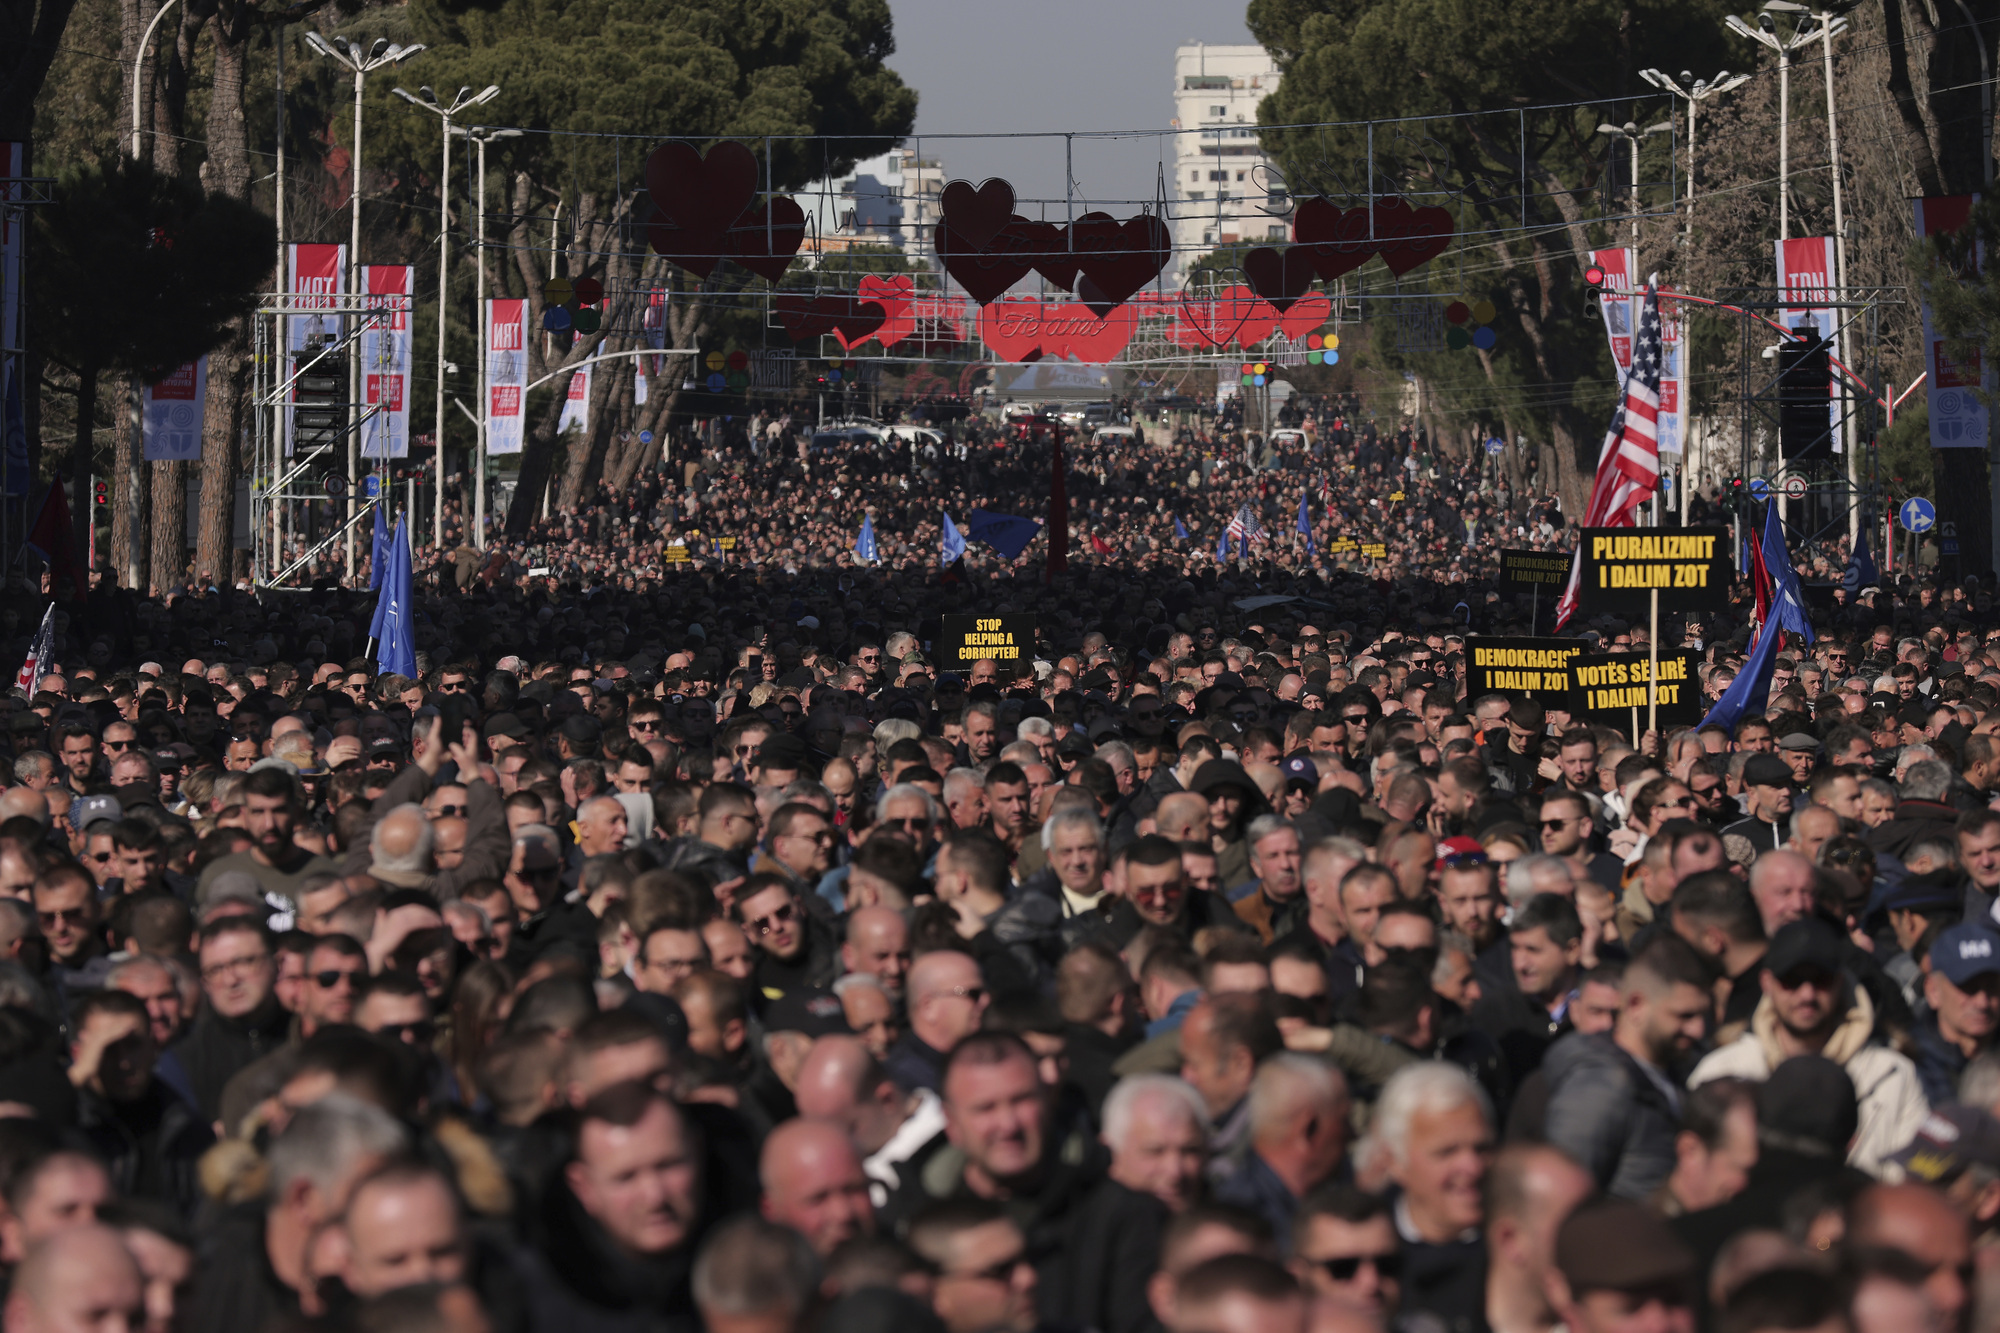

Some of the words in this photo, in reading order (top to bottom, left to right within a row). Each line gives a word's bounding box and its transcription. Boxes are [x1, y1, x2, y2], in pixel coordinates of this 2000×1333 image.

[998, 312, 1040, 338] Te
[1044, 316, 1109, 337] amo
[1592, 535, 1716, 561] PLURALIZMIT
[1506, 556, 1569, 572] DEMOKRACISË
[1516, 570, 1545, 583] DALIM
[1545, 572, 1562, 584] ZOT
[1599, 565, 1607, 588] I
[1610, 564, 1672, 588] DALIM
[1673, 564, 1711, 588] ZOT
[976, 618, 1002, 632] STOP
[964, 633, 1005, 646] HELPING
[1006, 632, 1014, 645] A
[958, 646, 1020, 660] CORRUPTER!
[1486, 670, 1492, 689] I
[1494, 670, 1541, 690] DALIM
[1576, 661, 1629, 687] VOTËS
[1629, 658, 1651, 683] SË
[1655, 656, 1688, 681] LIRË
[1587, 690, 1594, 710] I
[1596, 686, 1648, 709] DALIM
